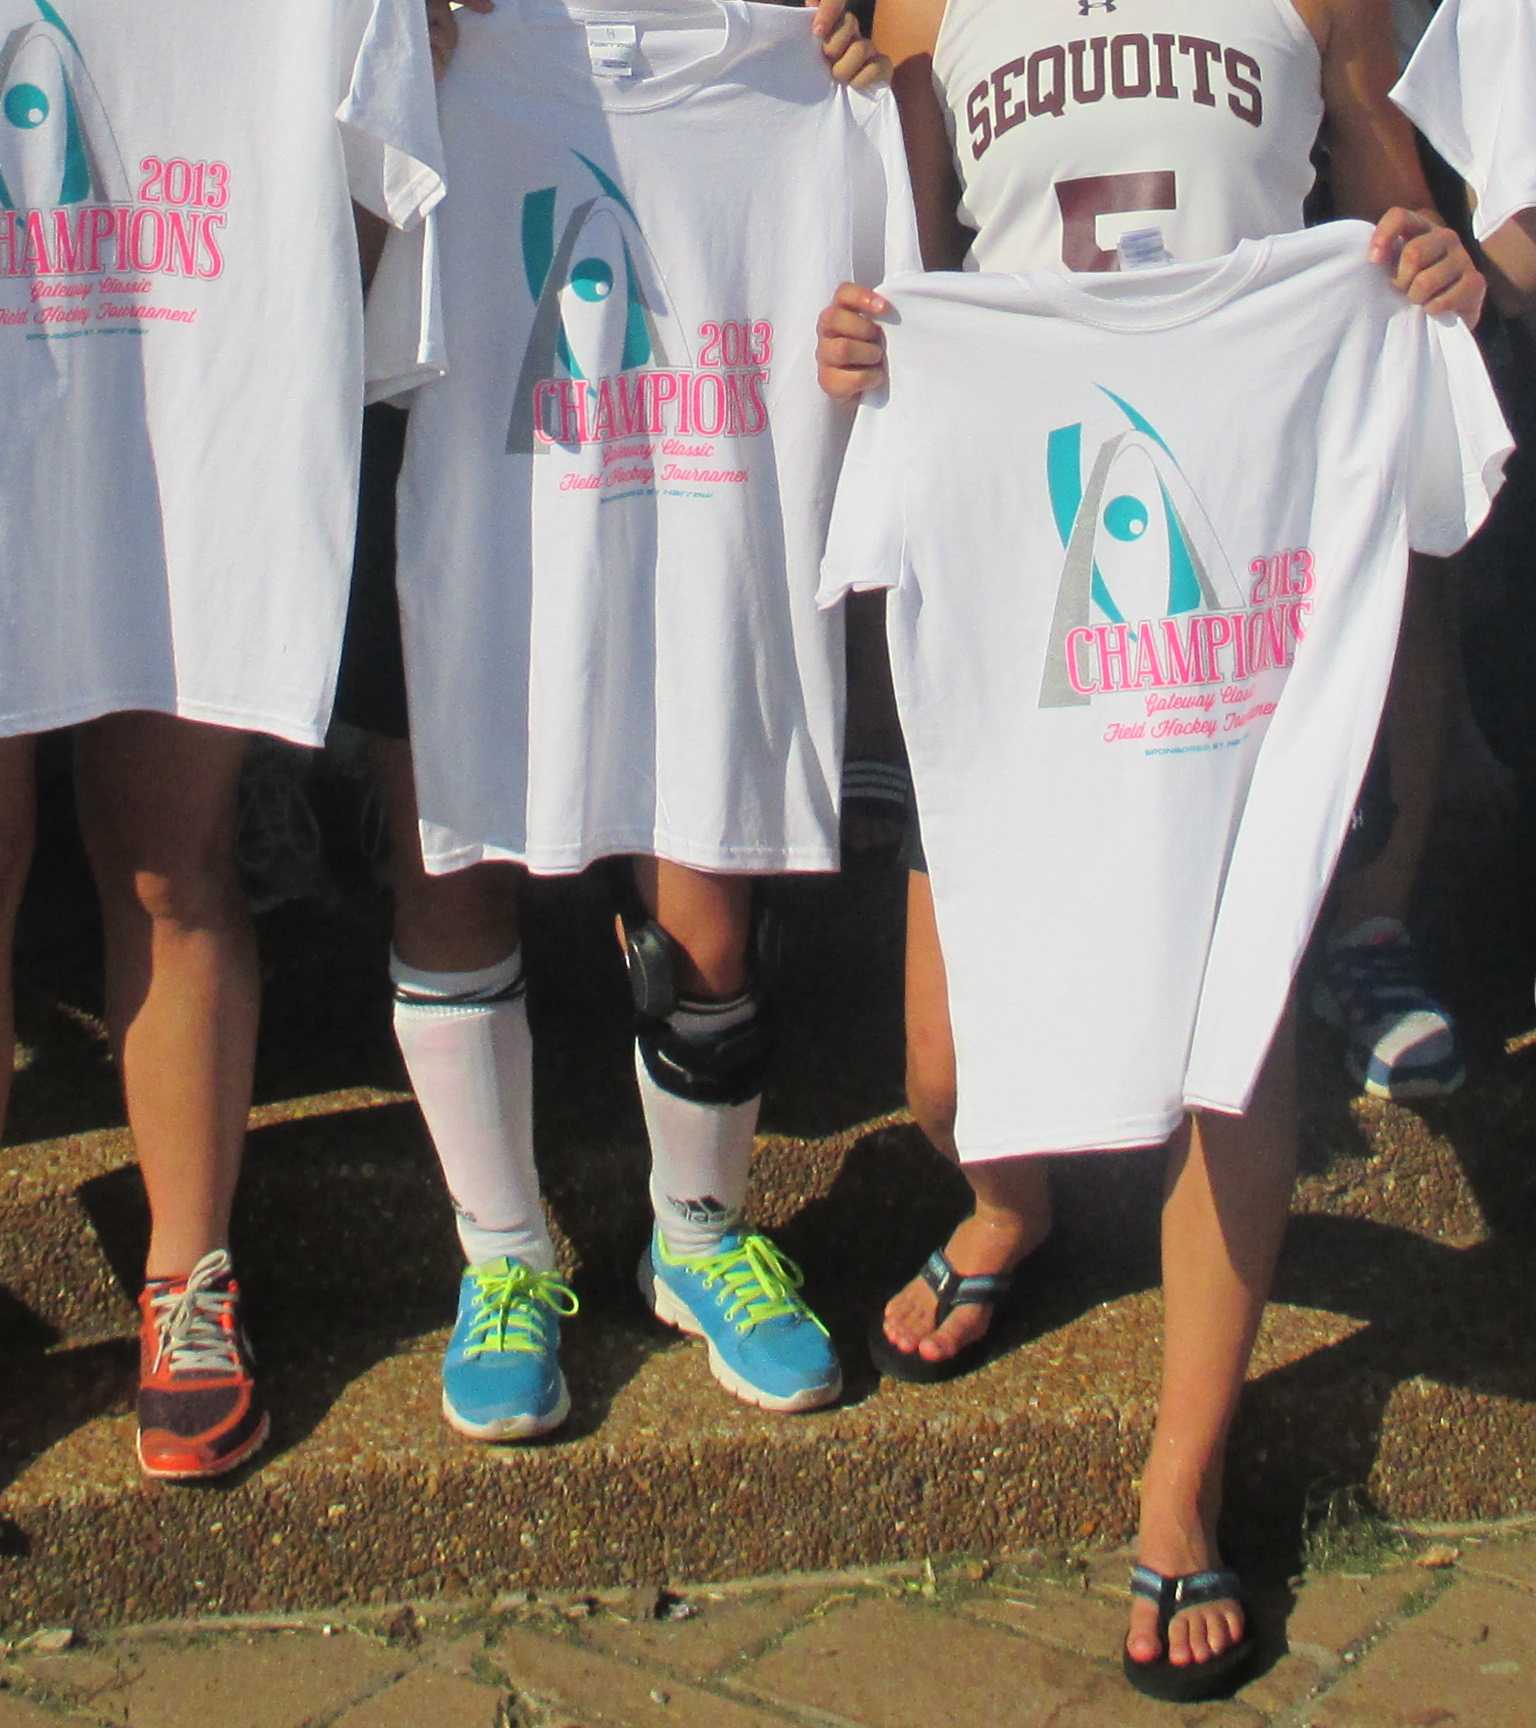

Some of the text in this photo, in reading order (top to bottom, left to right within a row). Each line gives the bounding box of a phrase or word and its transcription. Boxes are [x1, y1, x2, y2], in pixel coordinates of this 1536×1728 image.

[966, 32, 1263, 161] SEQUOITS
[137, 155, 231, 207] 2013
[96, 302, 199, 324] Tournament
[697, 320, 773, 368] 2013
[532, 368, 770, 446] CHAMPIONS
[660, 438, 715, 458] Classic
[559, 473, 602, 492] Field
[1248, 548, 1317, 606] 2013
[1144, 692, 1216, 717] Gateway
[1103, 718, 1217, 744] Field Hockey
